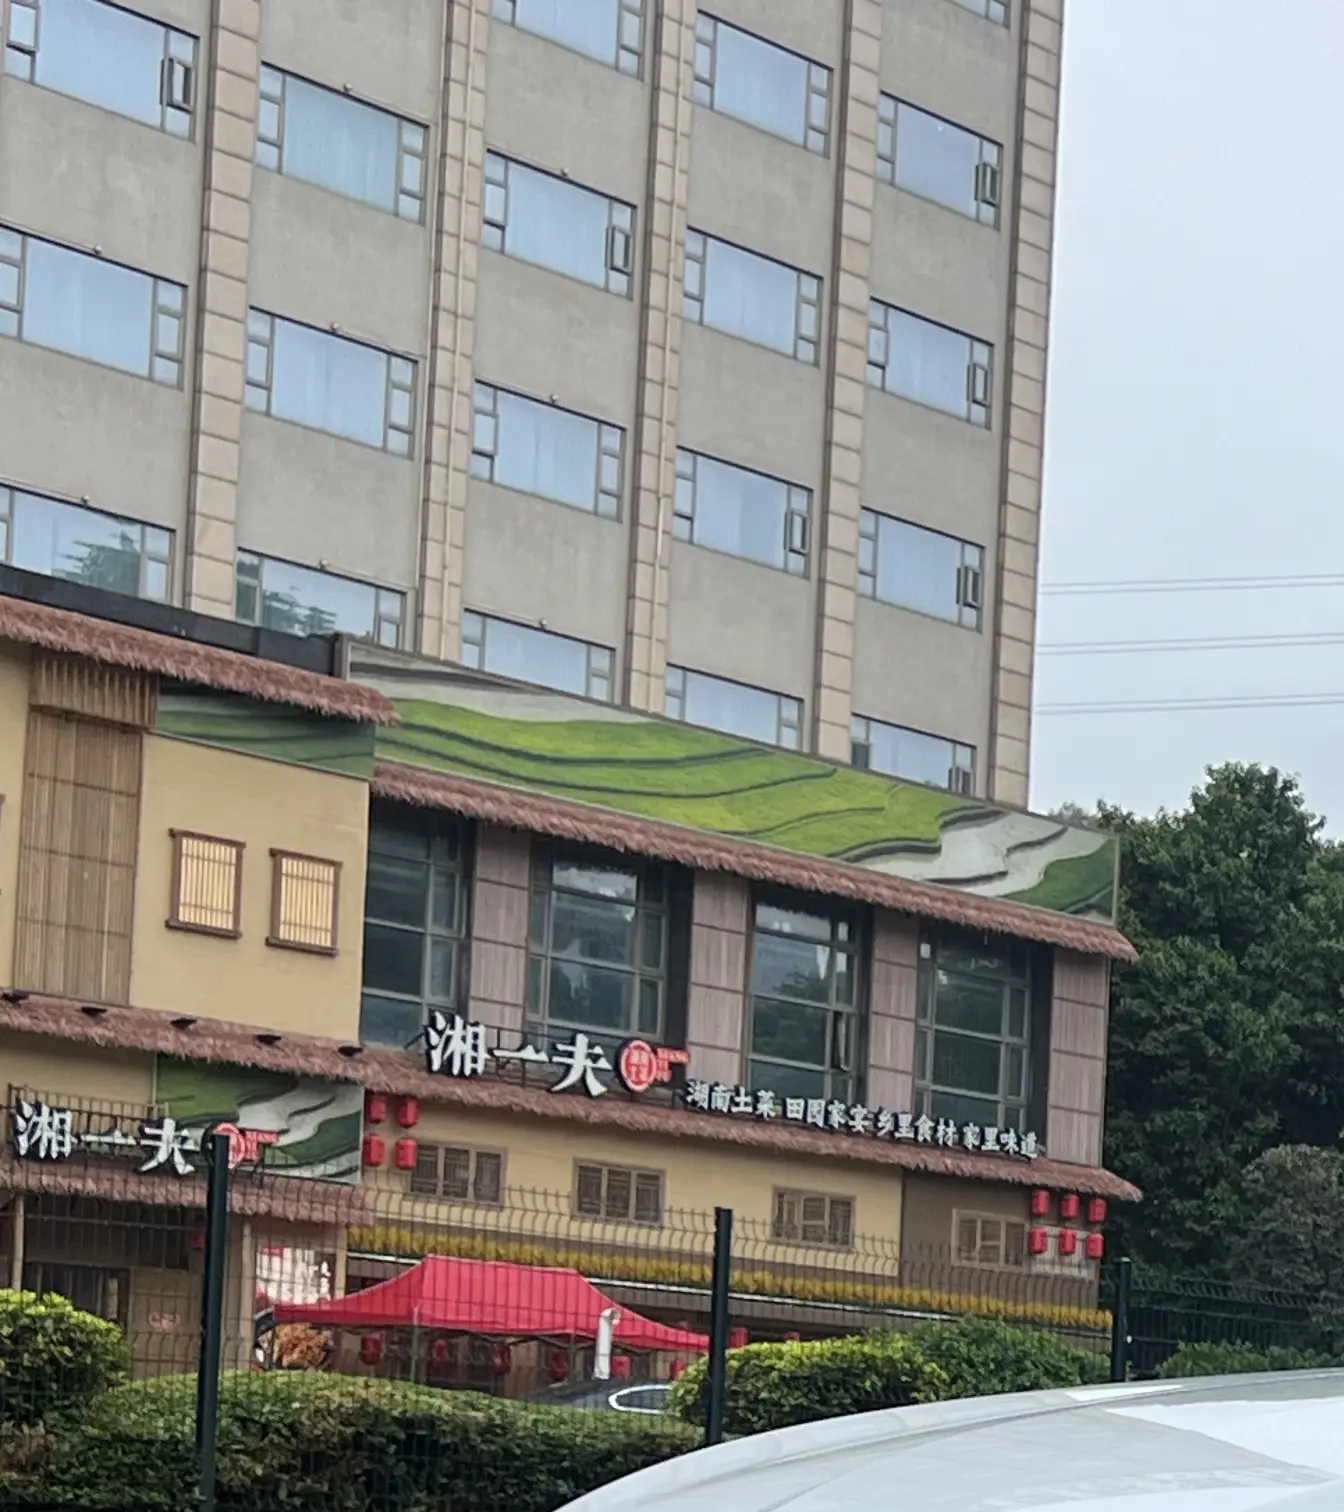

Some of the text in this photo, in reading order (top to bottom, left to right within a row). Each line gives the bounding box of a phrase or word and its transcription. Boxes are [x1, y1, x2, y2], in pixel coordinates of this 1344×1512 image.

[426, 1011, 613, 1097] 湘一夫
[15, 1100, 201, 1176] 湘一夫
[686, 1080, 777, 1120] 湖南土菜
